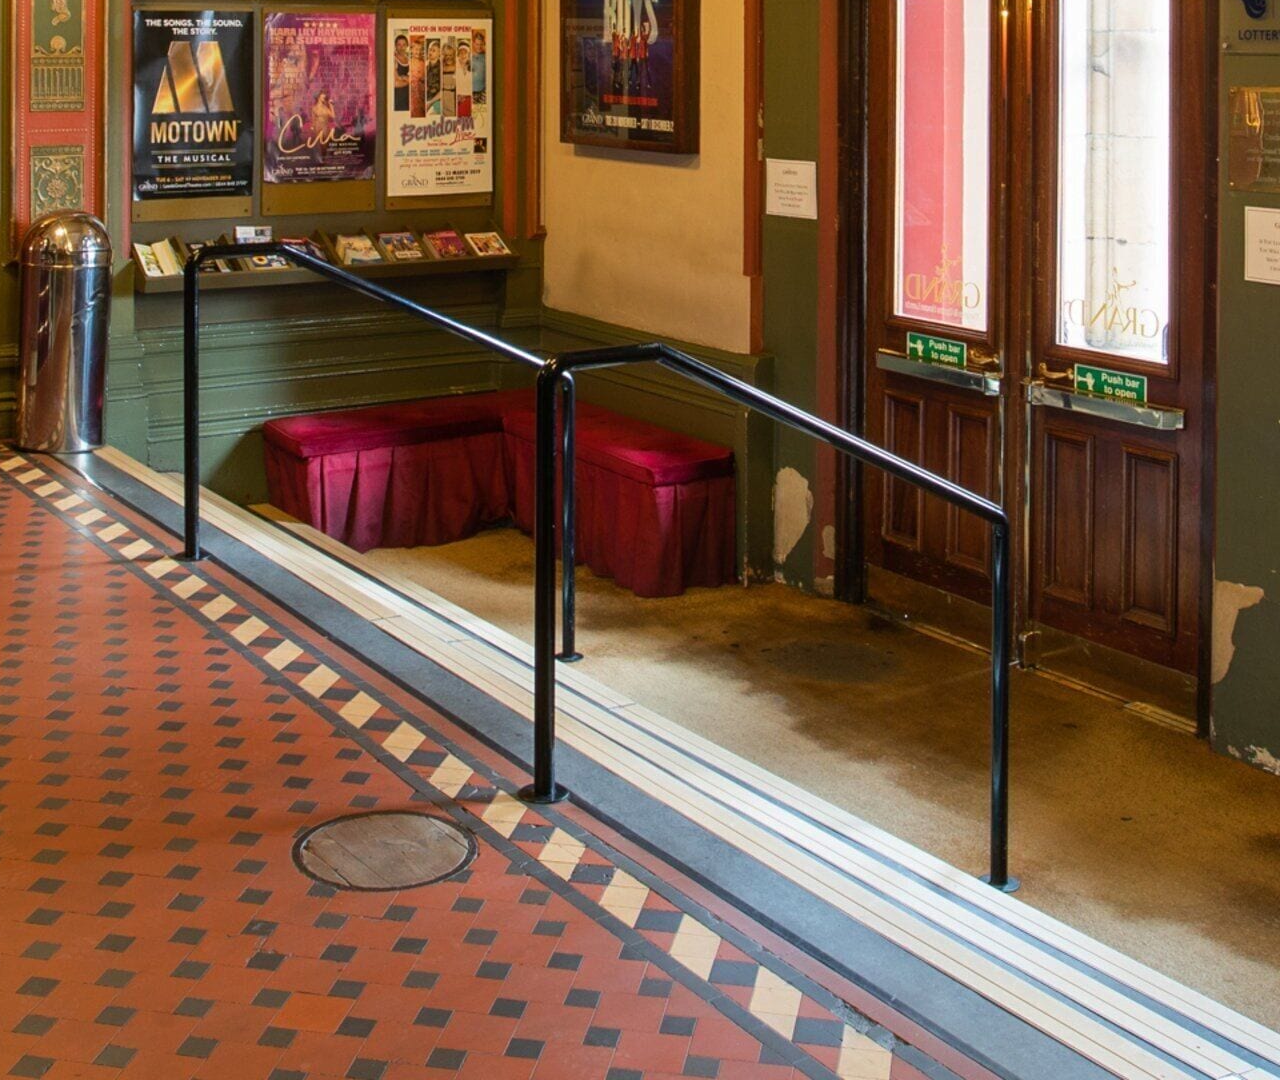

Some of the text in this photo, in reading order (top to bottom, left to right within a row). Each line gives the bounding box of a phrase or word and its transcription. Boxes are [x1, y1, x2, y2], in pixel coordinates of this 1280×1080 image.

[164, 19, 194, 27] SONGS.
[213, 19, 243, 27] SOUND.
[151, 120, 237, 144] MOTOWN
[278, 114, 361, 153] Cilla
[400, 116, 474, 146] Benidorm
[157, 154, 231, 163] THE MUSICAL
[929, 340, 960, 353] Push bar
[931, 351, 958, 363] to open
[1101, 373, 1140, 388] Push bar
[1104, 385, 1136, 399] to open
